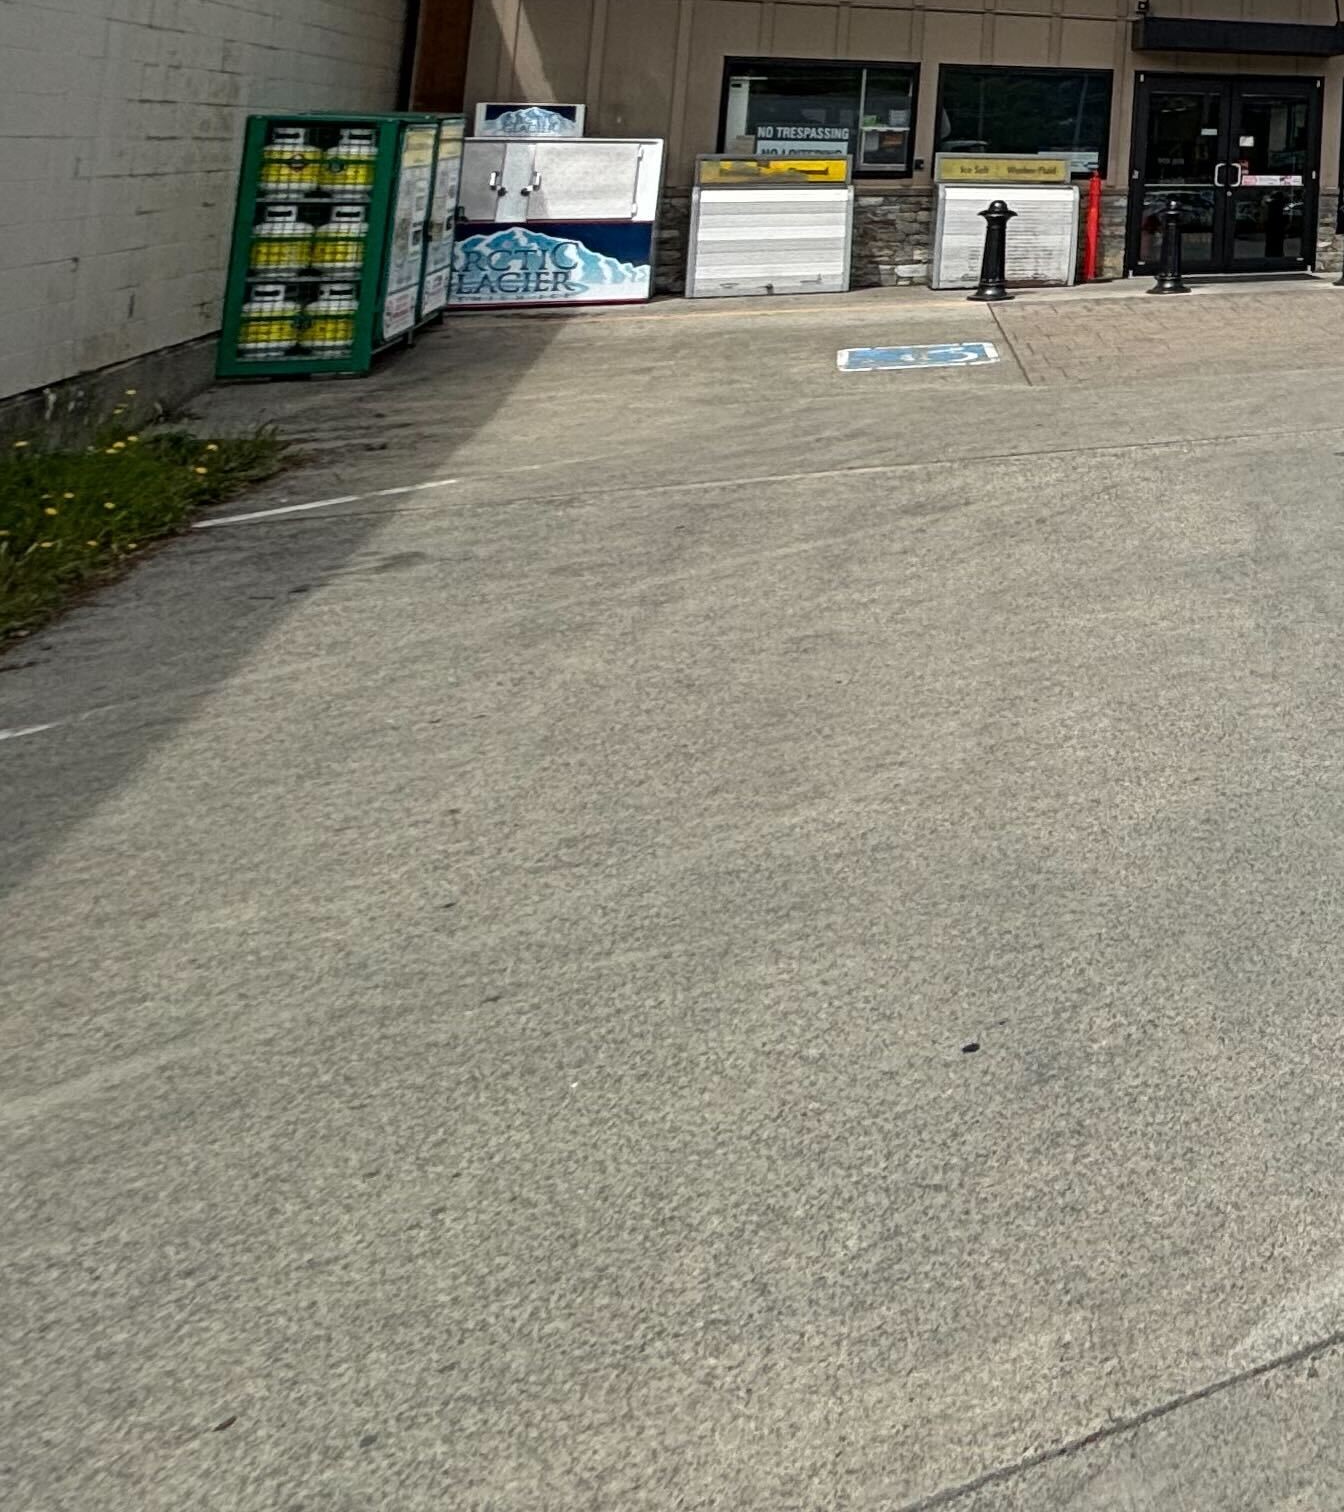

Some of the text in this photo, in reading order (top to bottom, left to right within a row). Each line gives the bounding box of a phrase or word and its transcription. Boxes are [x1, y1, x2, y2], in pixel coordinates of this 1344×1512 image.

[757, 126, 850, 140] NO TRESPASSING
[452, 242, 579, 272] RCTIC
[456, 271, 576, 295] LACIER
